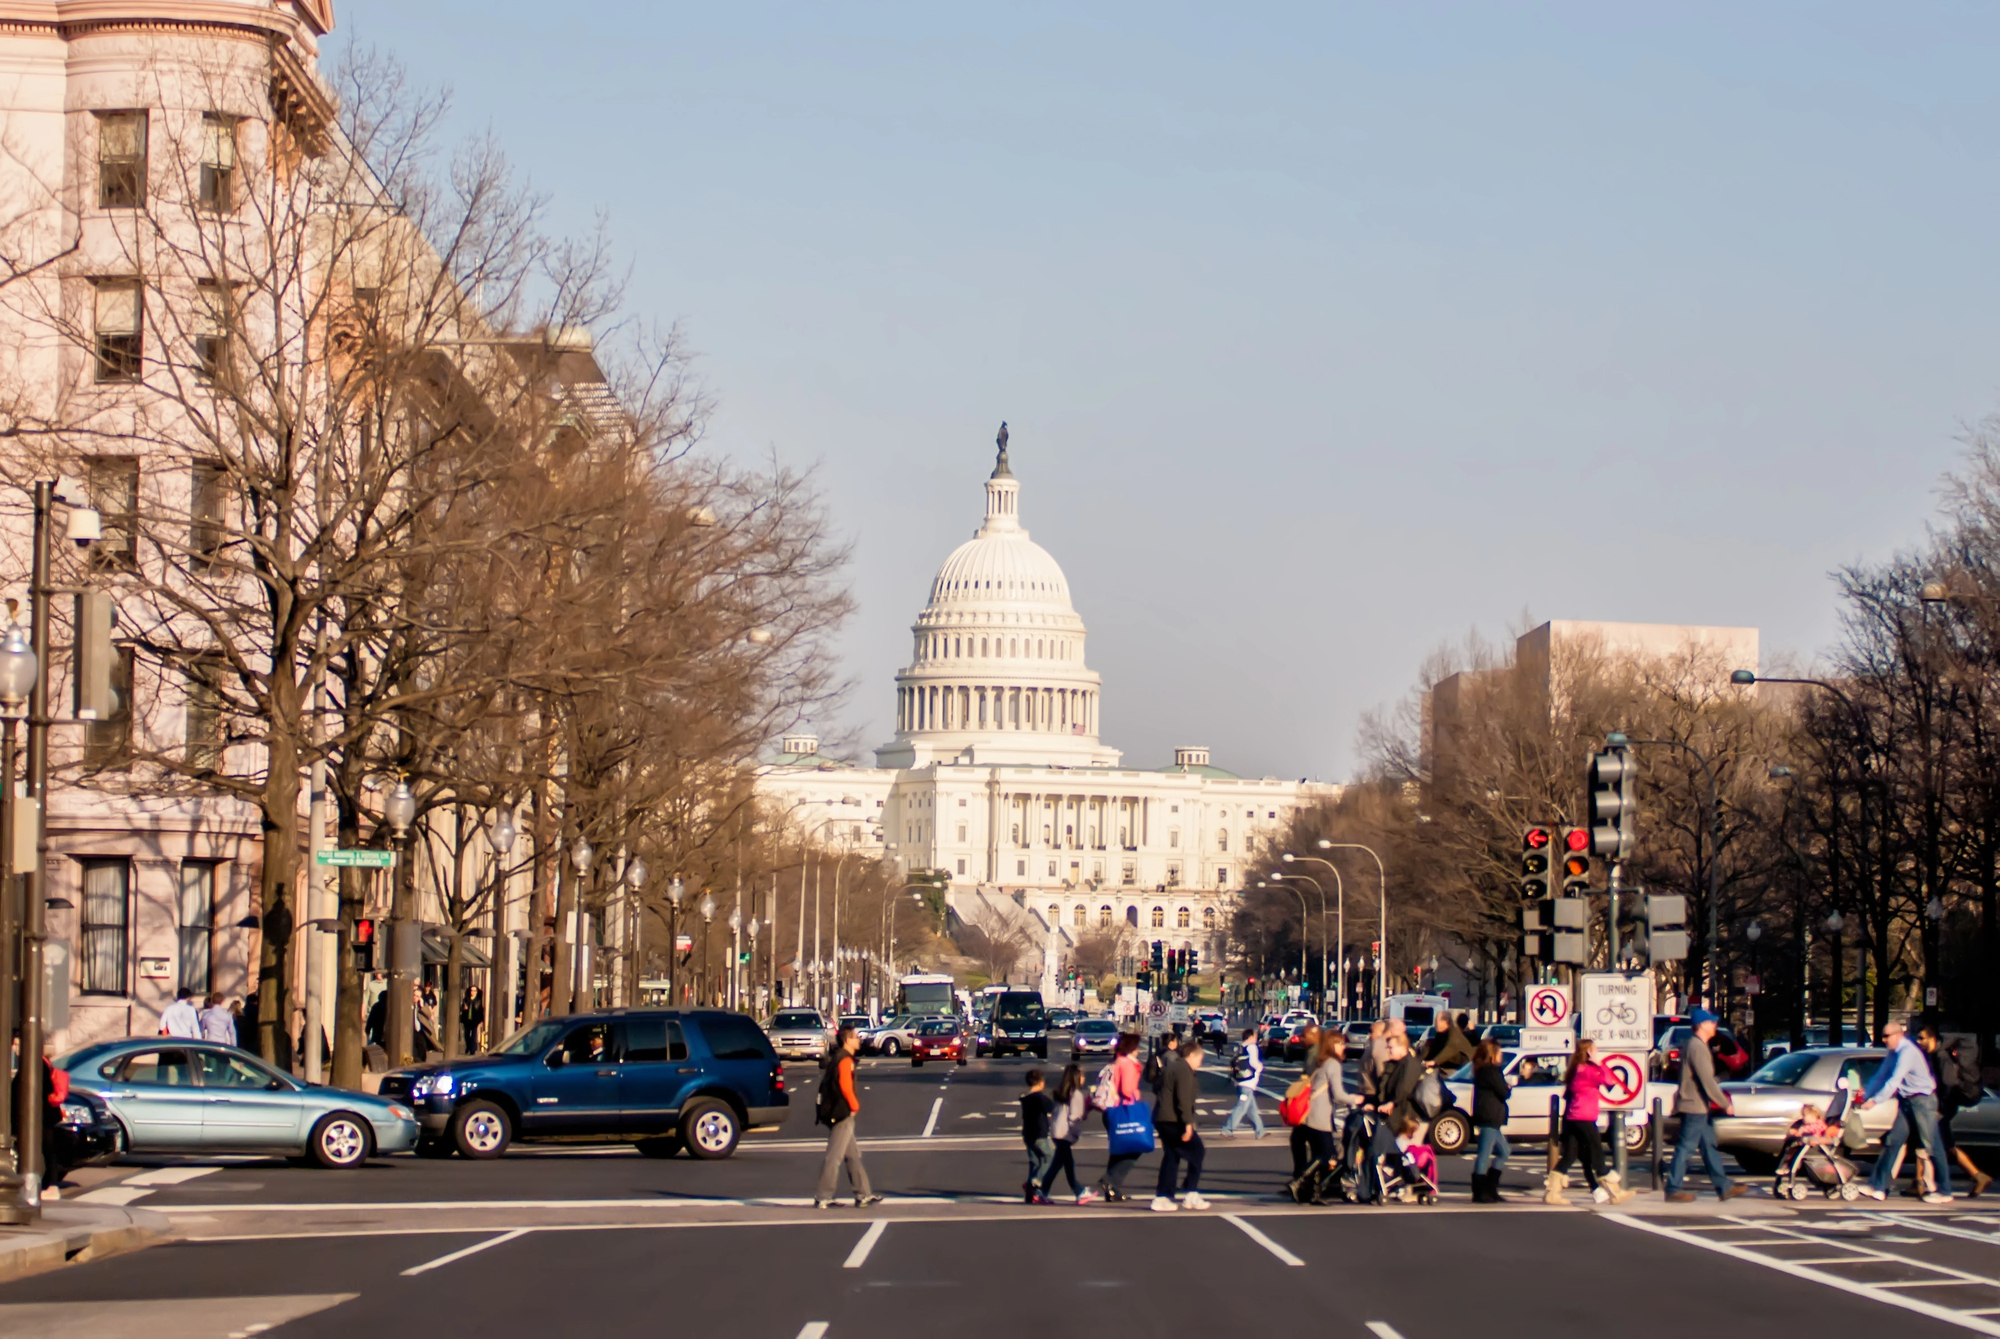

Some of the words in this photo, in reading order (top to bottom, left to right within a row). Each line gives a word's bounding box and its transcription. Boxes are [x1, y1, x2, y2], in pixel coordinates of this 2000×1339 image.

[356, 858, 382, 866] BLOCKS
[1598, 984, 1637, 996] TURNING
[1585, 1029, 1604, 1041] USE
[1608, 1029, 1648, 1041] X-WALKS
